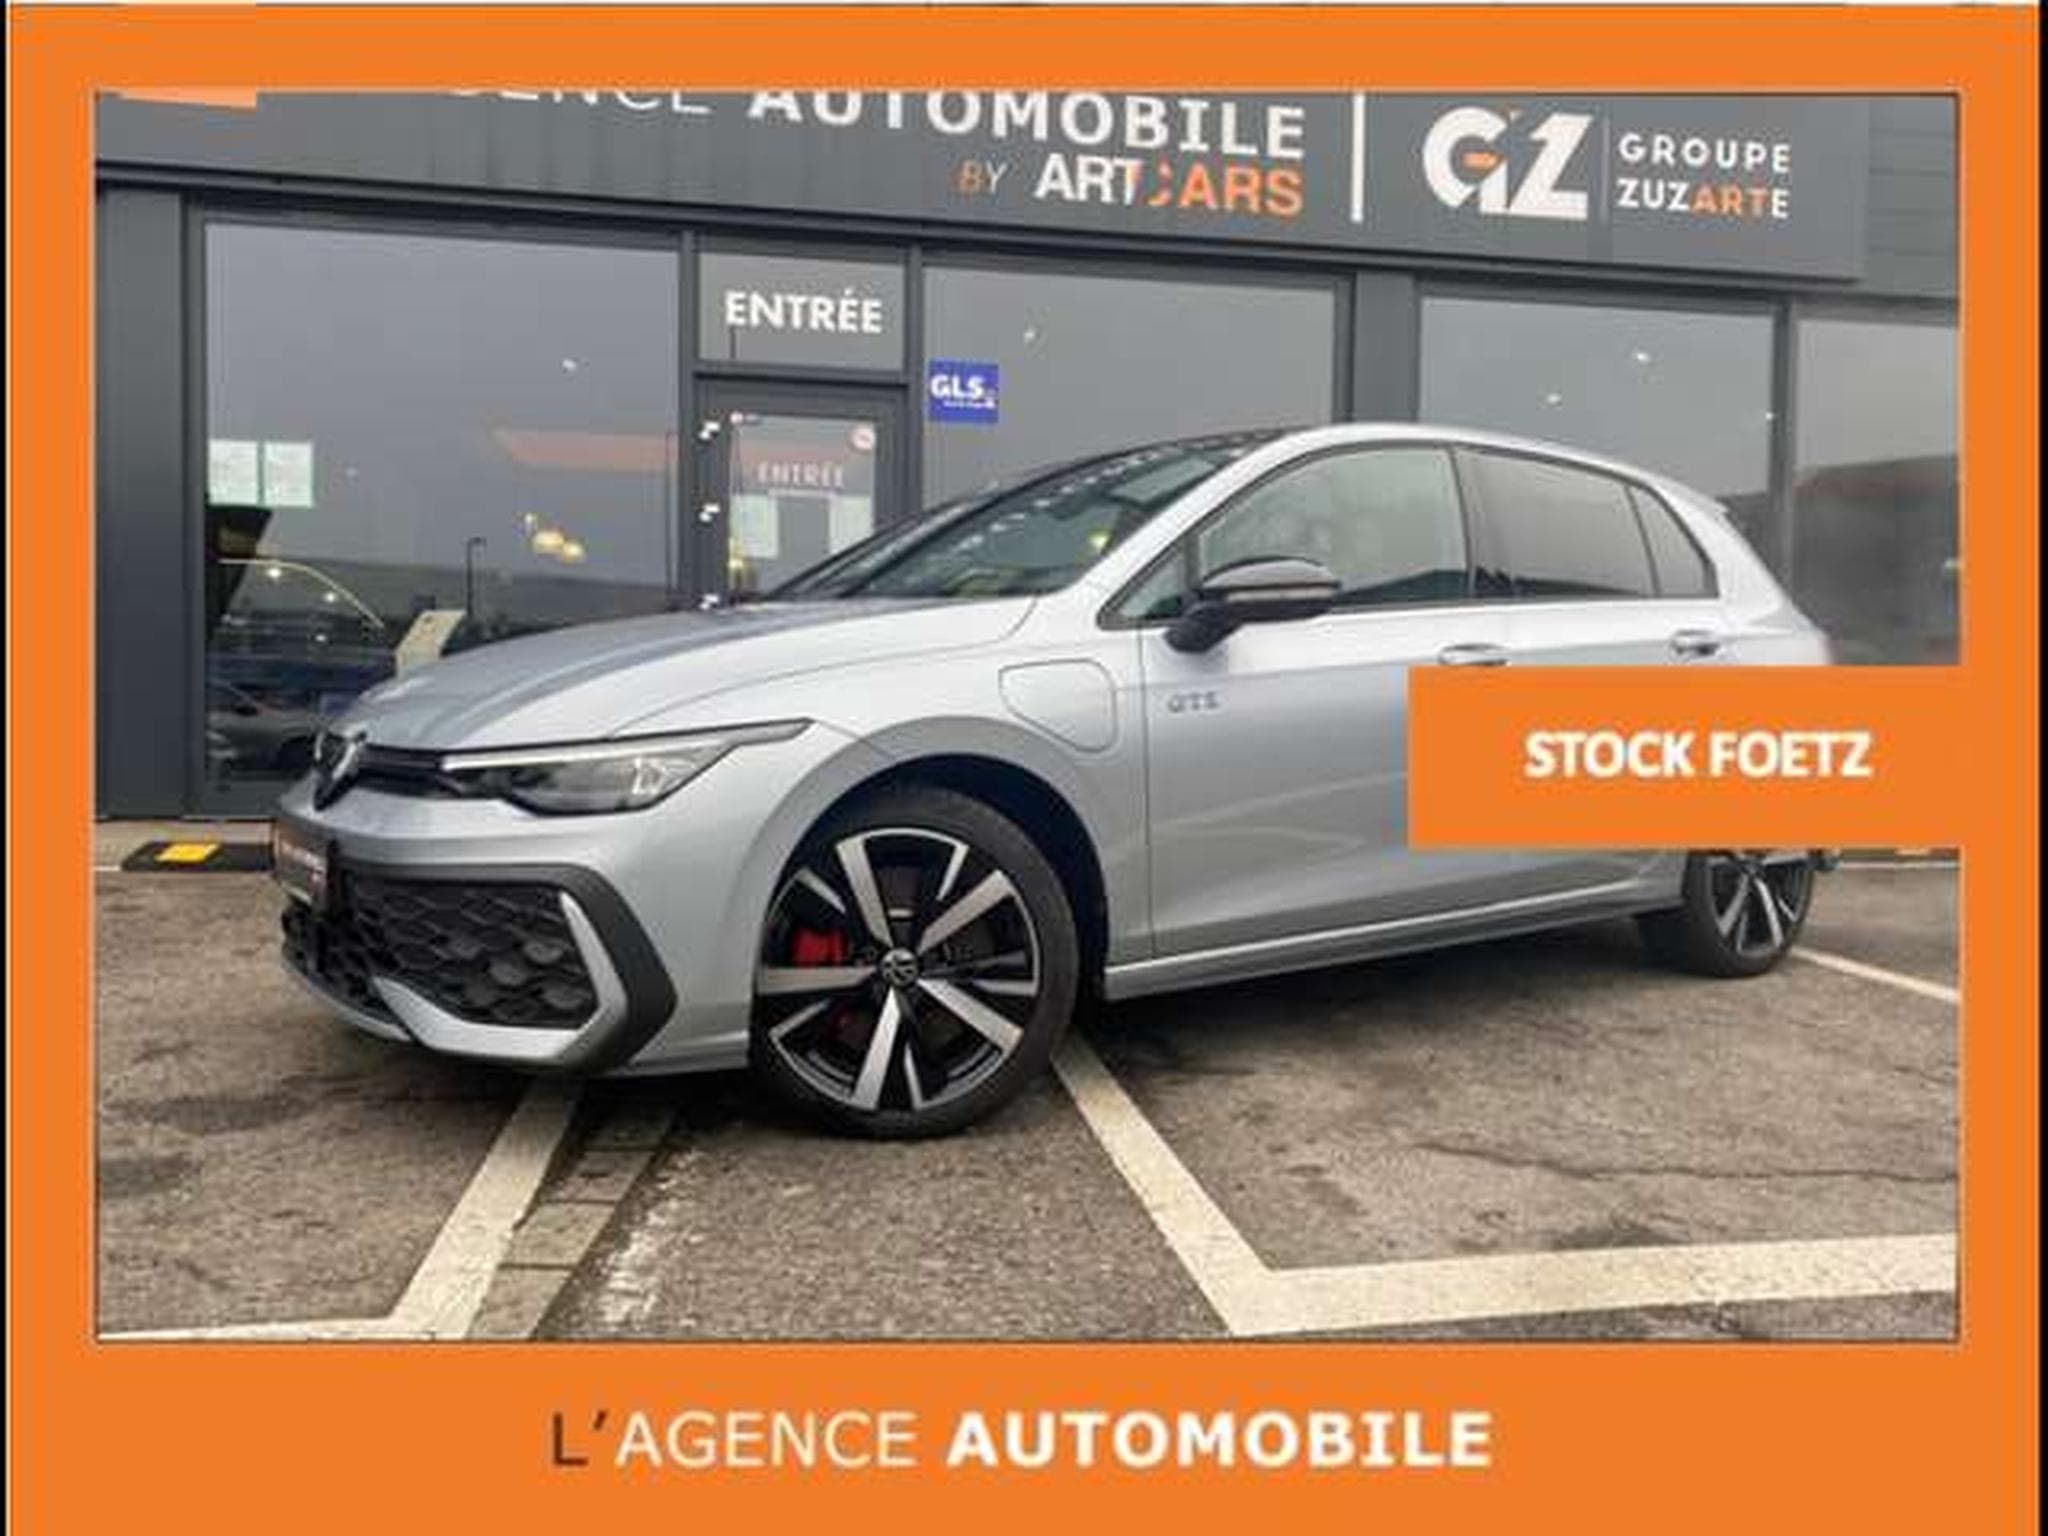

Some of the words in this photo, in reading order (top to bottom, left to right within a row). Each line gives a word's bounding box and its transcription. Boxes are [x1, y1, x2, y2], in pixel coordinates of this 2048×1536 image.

[1617, 131, 1791, 174] GROUPE
[957, 158, 1008, 194] BY
[1616, 176, 1790, 219] ZUZARTE
[724, 287, 882, 334] ENTRÉE
[930, 374, 985, 399] GLS
